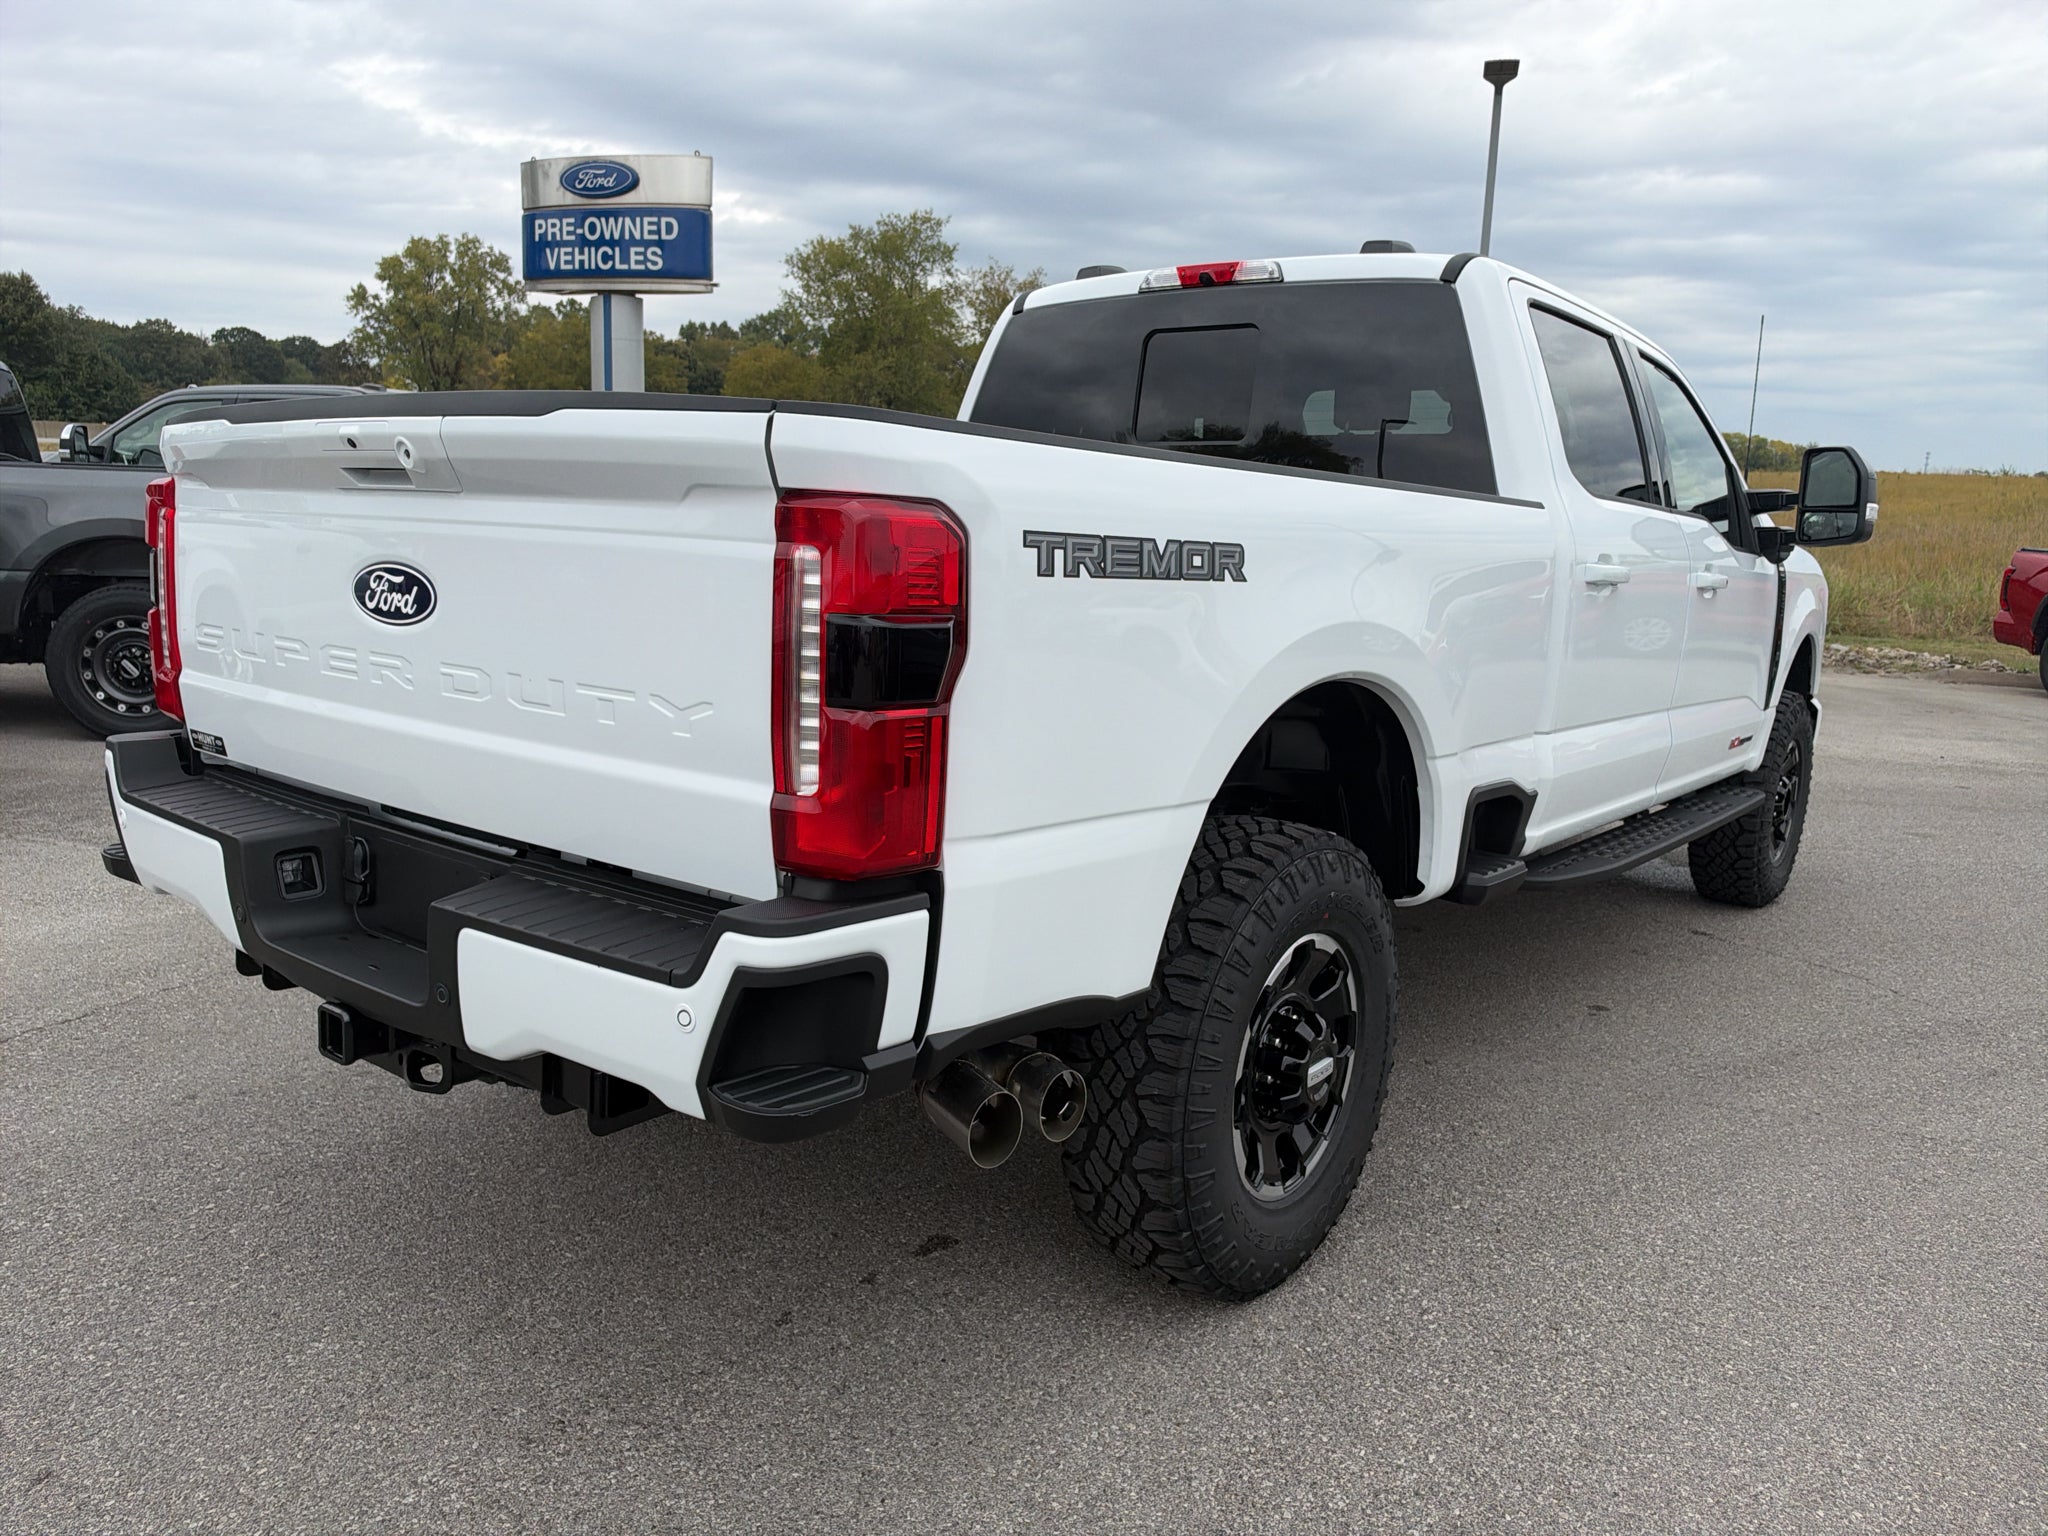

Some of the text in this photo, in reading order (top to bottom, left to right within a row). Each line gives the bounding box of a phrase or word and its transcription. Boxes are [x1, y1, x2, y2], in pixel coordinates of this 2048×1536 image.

[574, 168, 618, 189] Ford
[534, 216, 679, 242] PRE-OWNED
[545, 246, 664, 271] VEHICLES
[1023, 529, 1248, 582] TREMOR
[364, 569, 419, 616] Ford
[195, 621, 715, 738] SUPER DUTY
[197, 732, 216, 747] HUNT
